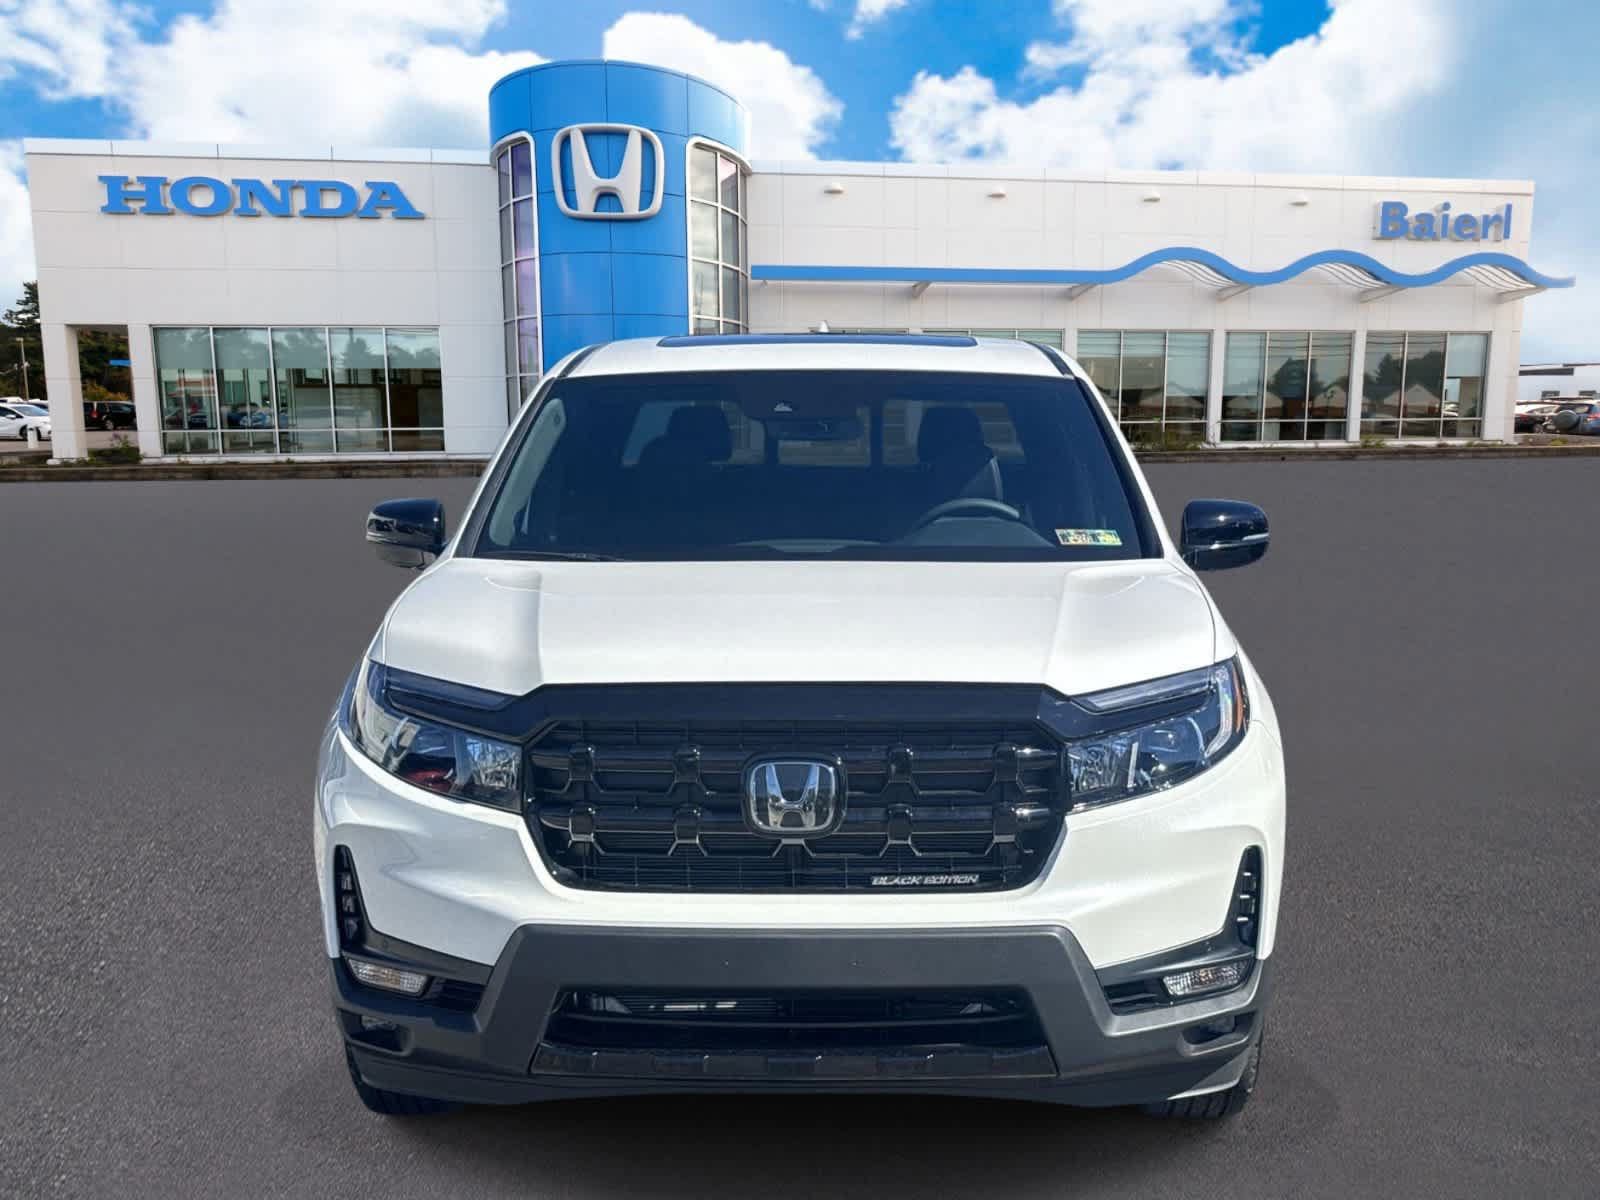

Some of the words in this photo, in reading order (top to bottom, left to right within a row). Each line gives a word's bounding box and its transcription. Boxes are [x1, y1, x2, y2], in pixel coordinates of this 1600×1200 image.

[98, 175, 425, 219] HONDA
[1379, 200, 1513, 239] Baierl
[871, 875, 922, 886] BLACK
[923, 873, 980, 885] EDITION
